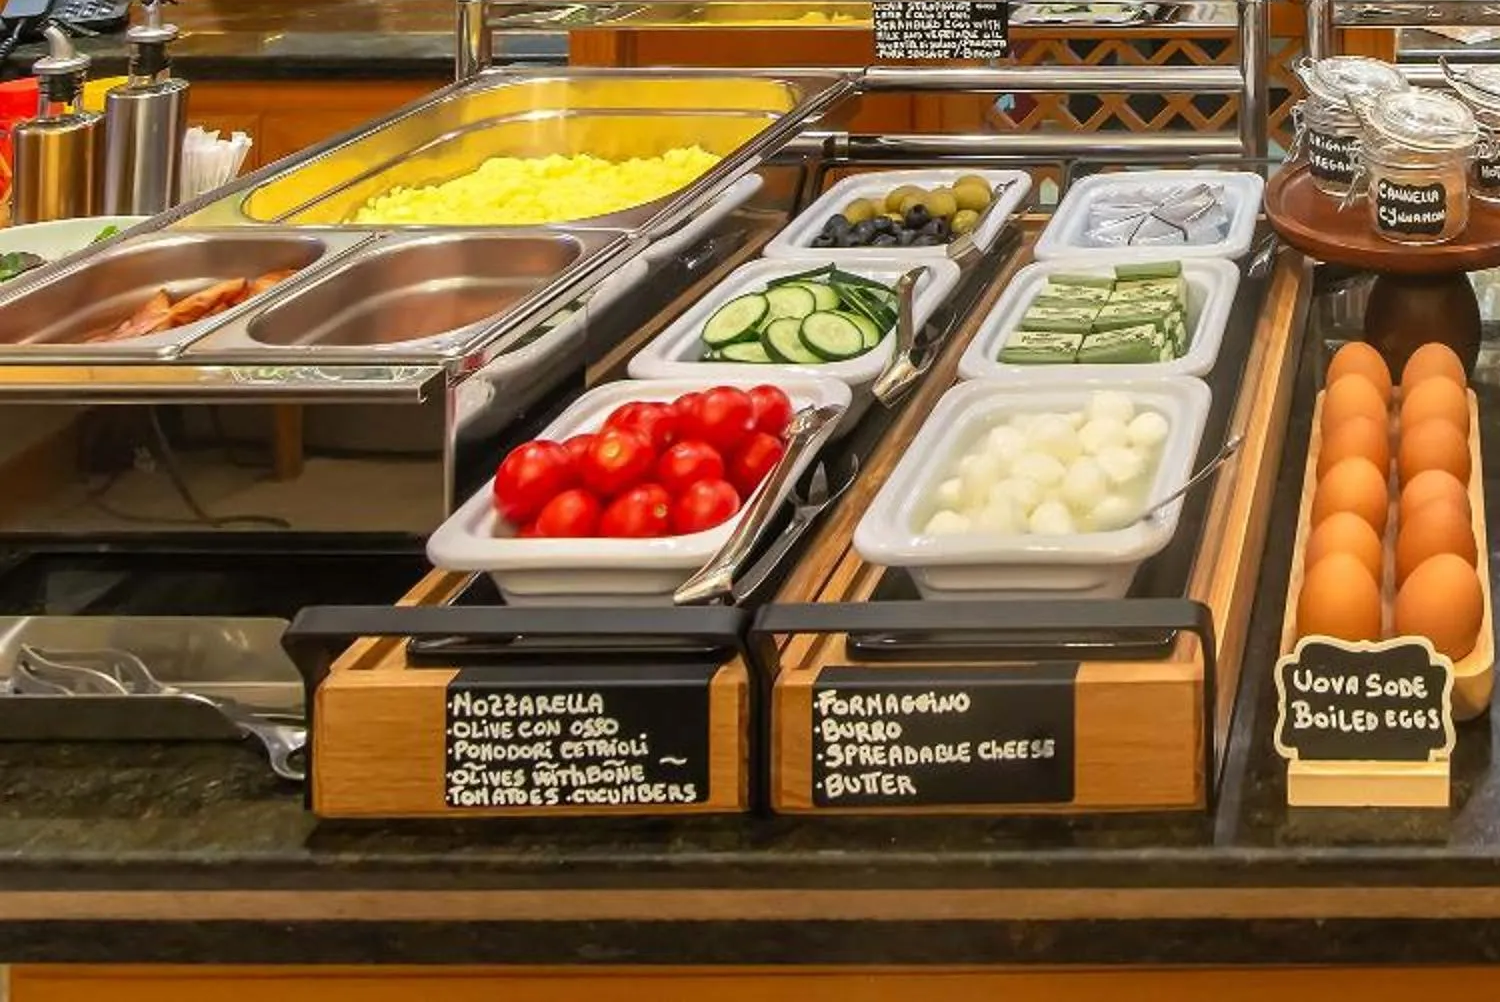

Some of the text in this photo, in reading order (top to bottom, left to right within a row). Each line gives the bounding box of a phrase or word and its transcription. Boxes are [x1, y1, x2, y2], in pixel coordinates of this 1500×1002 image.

[1292, 668, 1429, 699] UOVA SODE
[452, 692, 605, 717] MOZZARELLA
[517, 719, 562, 738] CON
[569, 716, 621, 739] OSSO
[1384, 707, 1441, 730] EGGS
[820, 719, 903, 744] BURRO
[824, 742, 972, 769] SPREADABLE
[450, 786, 560, 806] TOMATOES
[824, 771, 918, 799] BUTTER
